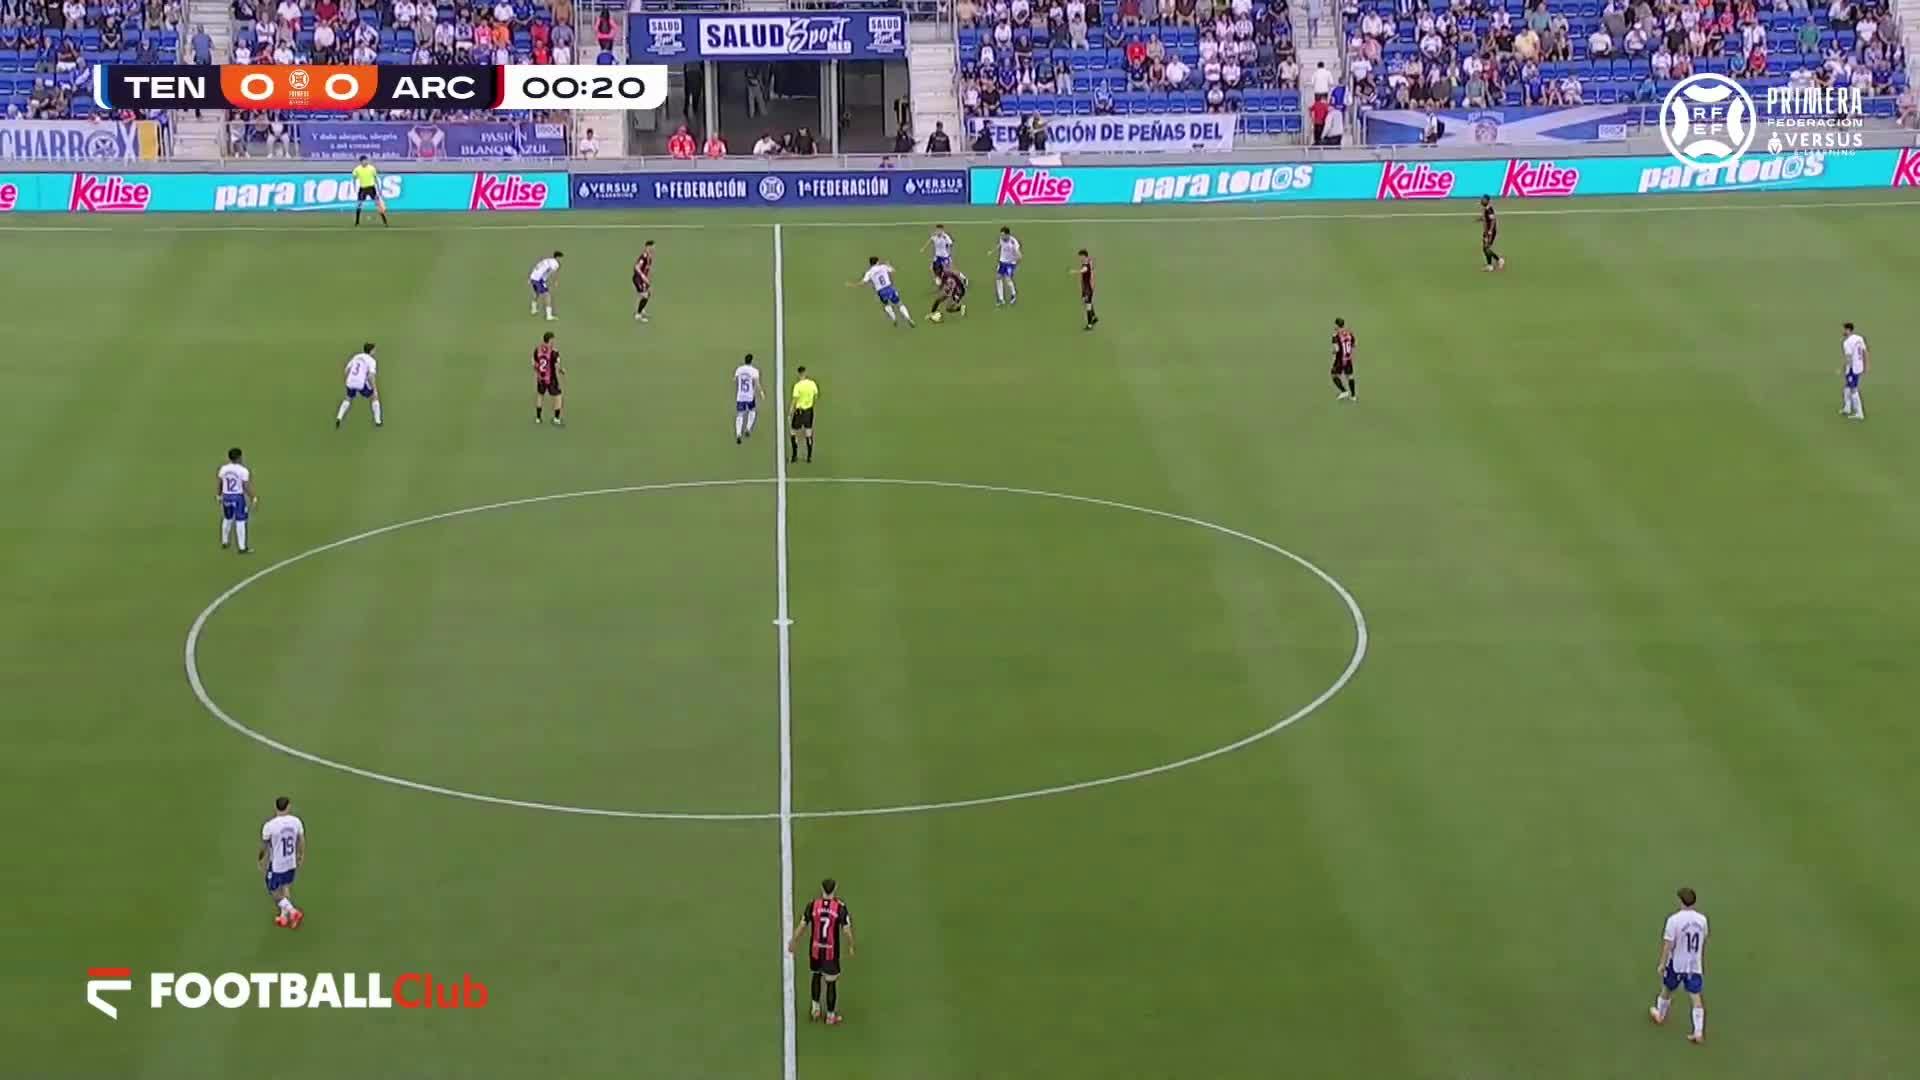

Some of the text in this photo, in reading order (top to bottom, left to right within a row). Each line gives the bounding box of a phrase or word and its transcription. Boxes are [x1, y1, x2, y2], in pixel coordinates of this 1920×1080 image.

[650, 21, 680, 31] SALUD
[707, 24, 784, 48] SALUD
[788, 17, 850, 52] Sport
[871, 19, 899, 29] SALUD
[1101, 123, 1124, 141] DE
[1128, 120, 1186, 141] PEÑAS
[1190, 122, 1222, 140] DEL
[590, 182, 638, 193] VERSUS
[670, 177, 747, 198] FEDERACIÓN
[813, 176, 889, 197] FEDERACIÓN
[916, 177, 963, 189] VERSUS
[996, 166, 1074, 205] Kalise
[1131, 172, 1210, 203] para
[1376, 160, 1455, 200] Kalise
[1500, 158, 1579, 198] Kalise
[70, 172, 150, 211] Kalise
[214, 179, 297, 211] para
[469, 171, 549, 211] Kalise
[226, 477, 238, 492] 12
[820, 917, 830, 938] 7
